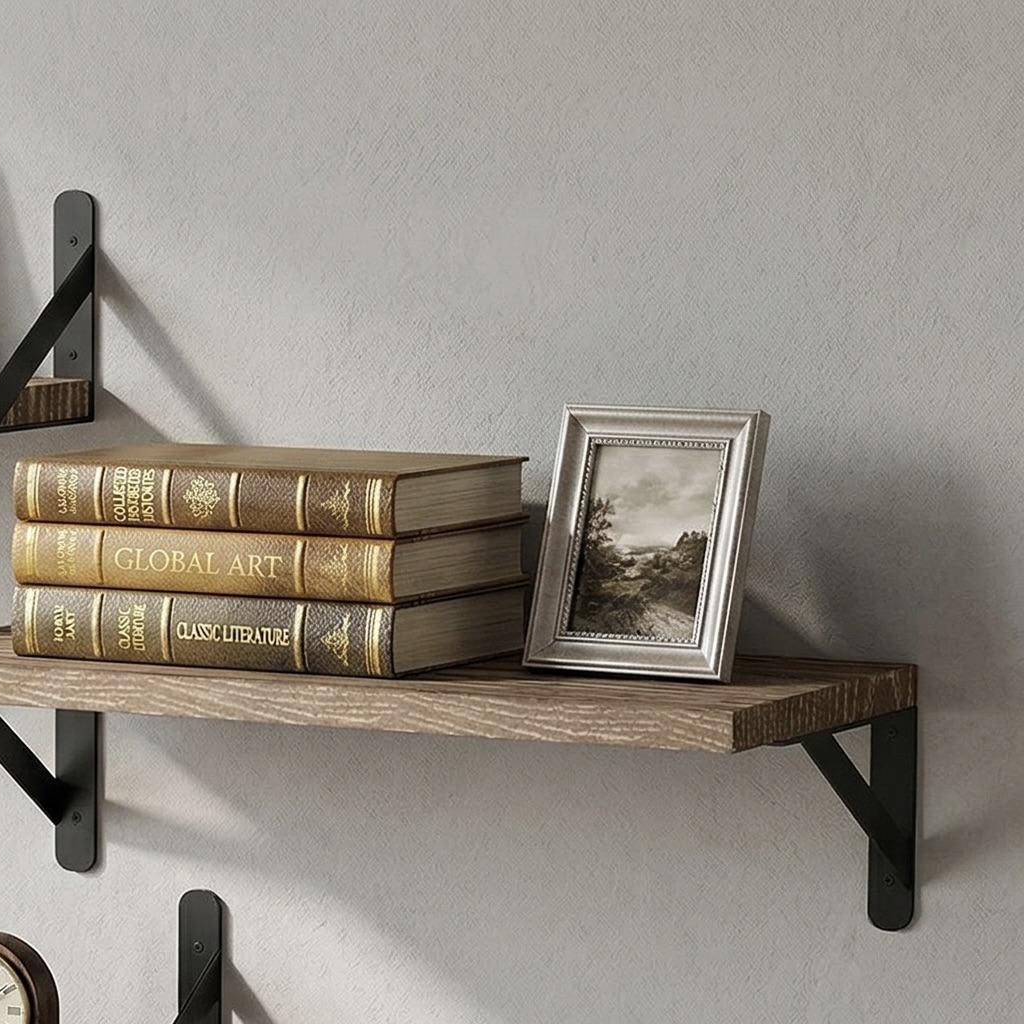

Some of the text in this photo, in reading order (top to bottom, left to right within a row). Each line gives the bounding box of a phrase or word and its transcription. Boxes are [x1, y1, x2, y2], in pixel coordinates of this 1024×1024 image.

[114, 547, 283, 579] GLOBAL ART
[176, 621, 291, 646] CLASSIC LITERATURE
